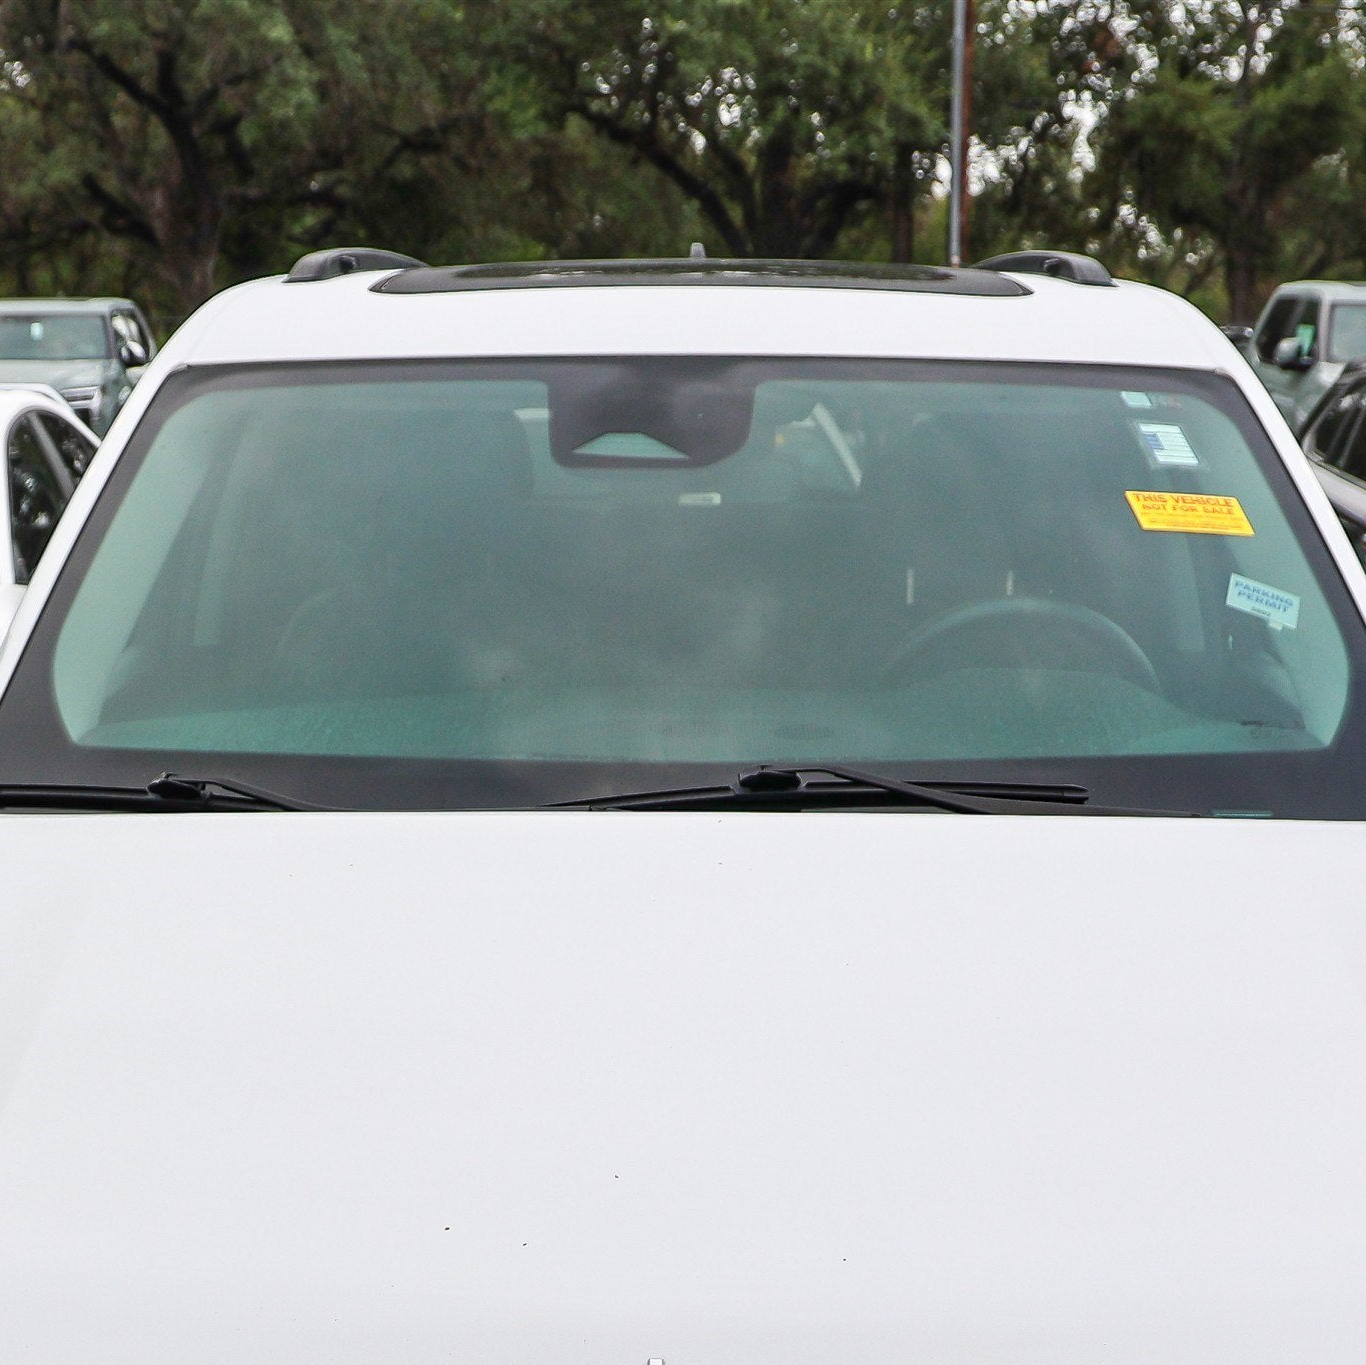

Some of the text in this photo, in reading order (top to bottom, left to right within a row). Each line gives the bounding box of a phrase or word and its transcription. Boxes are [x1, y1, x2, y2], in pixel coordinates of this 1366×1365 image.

[1132, 493, 1235, 508] THIS VEHICLE
[1142, 503, 1235, 515] NOT FOR SALE
[1235, 580, 1293, 607] PARKING
[1238, 589, 1290, 613] PERMIT
